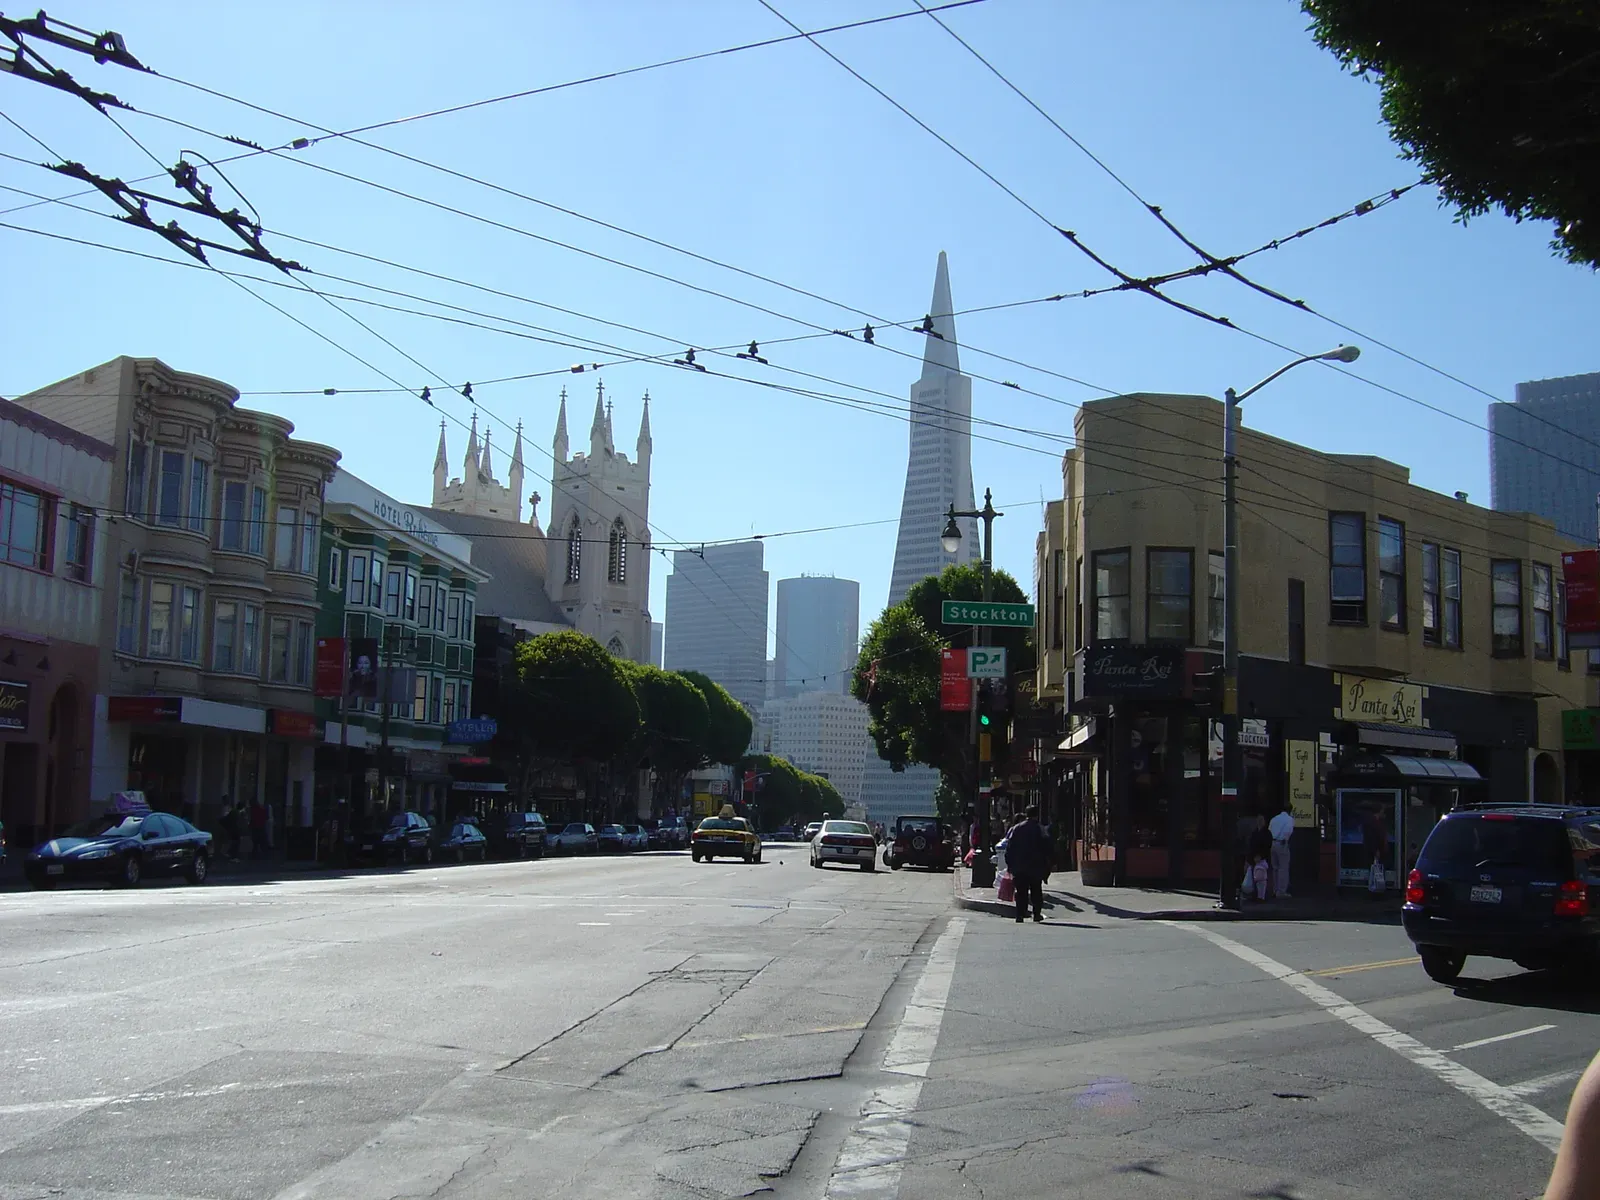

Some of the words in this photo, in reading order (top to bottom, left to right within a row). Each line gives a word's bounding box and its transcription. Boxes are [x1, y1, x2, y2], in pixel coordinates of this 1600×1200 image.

[373, 499, 401, 526] HOTEL
[950, 606, 1028, 621] Stockton
[1092, 654, 1138, 675] Panta
[1140, 655, 1173, 681] Rei
[1018, 679, 1037, 693] Pan
[1348, 678, 1388, 715] Panta
[1391, 687, 1417, 724] Rei
[455, 722, 494, 733] STELLA
